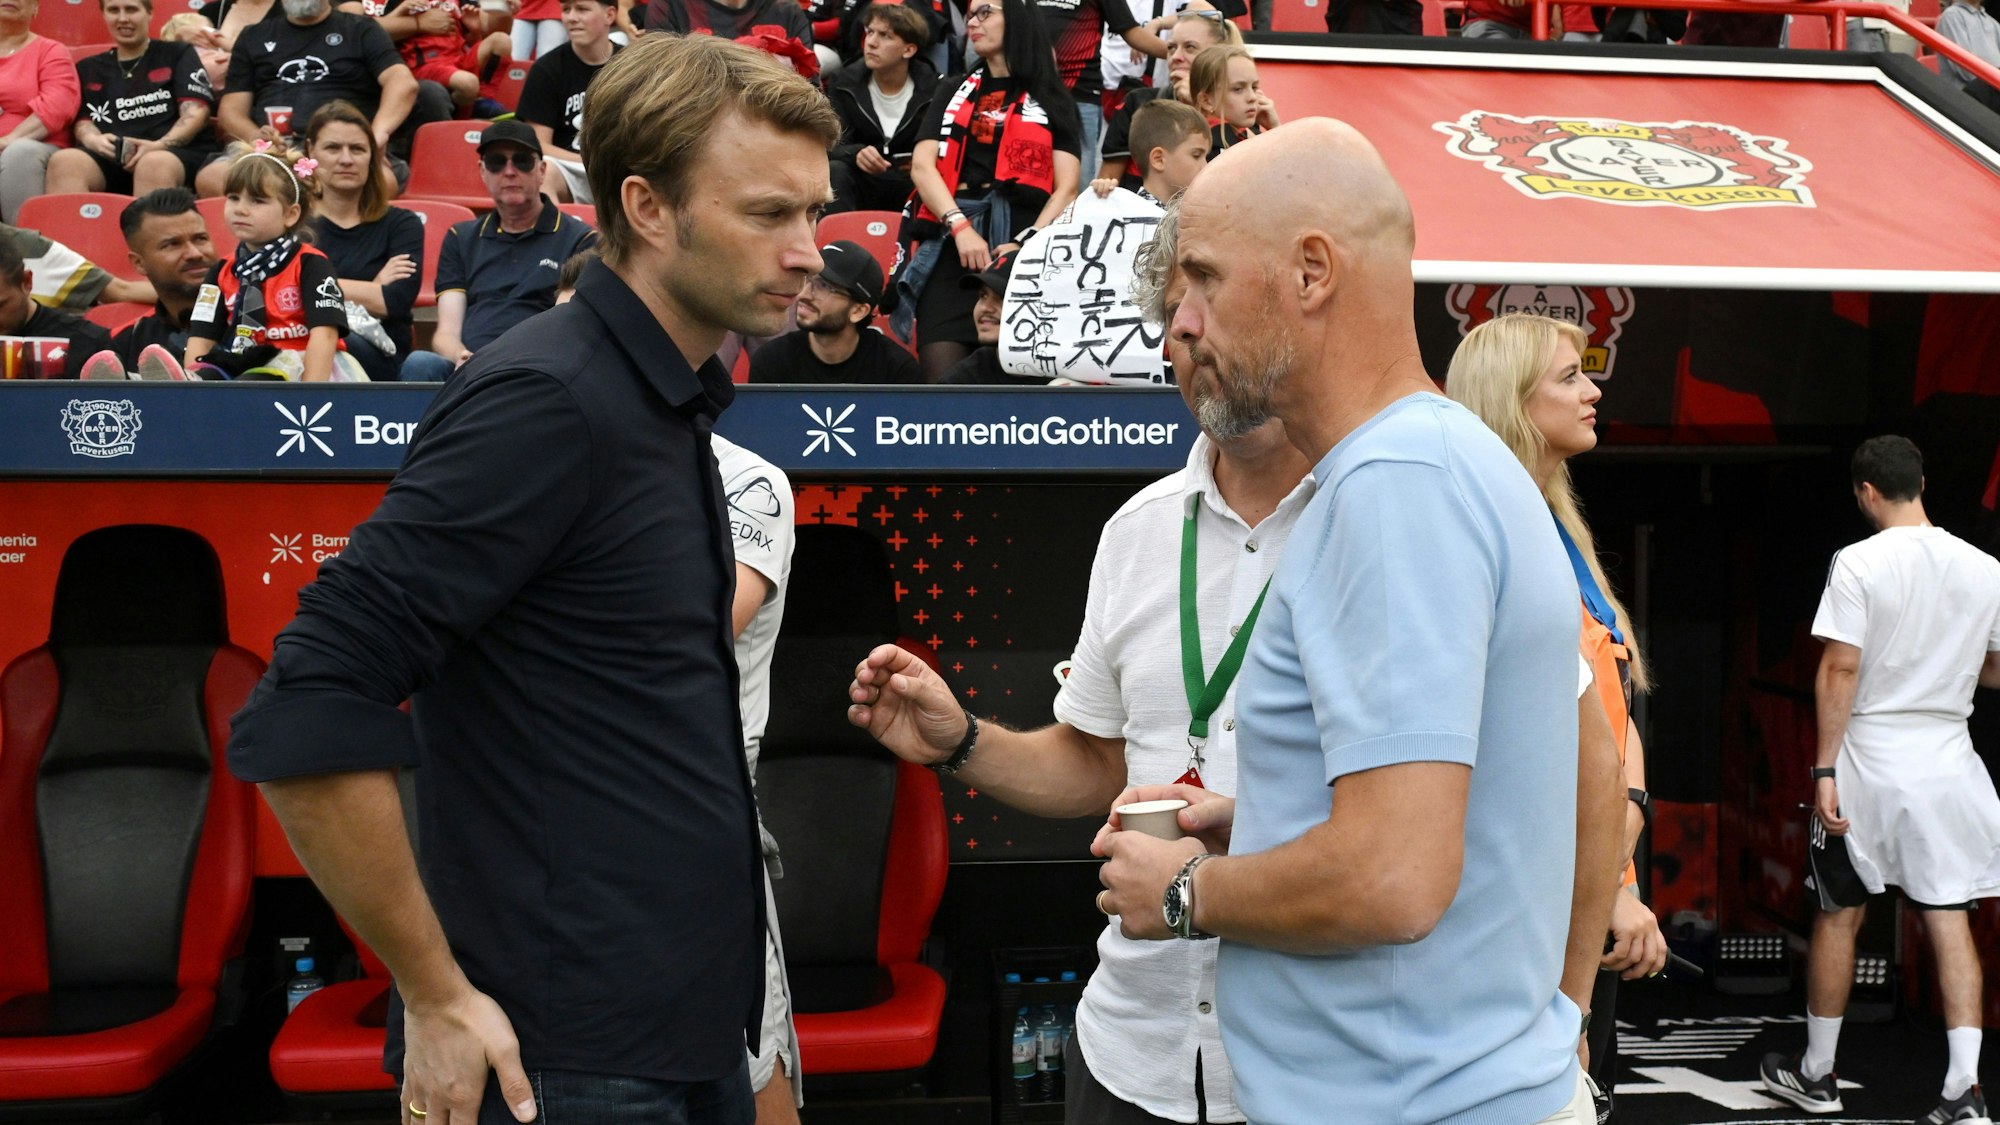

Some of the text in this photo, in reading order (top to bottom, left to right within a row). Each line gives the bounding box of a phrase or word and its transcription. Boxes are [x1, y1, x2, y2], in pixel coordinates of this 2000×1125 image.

[115, 88, 171, 109] Barmenia
[117, 103, 168, 121] Gothaer
[1546, 178, 1781, 203] Leverkusen
[91, 403, 111, 411] 1904
[85, 425, 119, 433] BAYER
[98, 413, 106, 445] BAYER
[354, 415, 419, 445] Bar
[875, 415, 1179, 446] BarmeniaGothaer
[76, 444, 129, 456] Leverkusen
